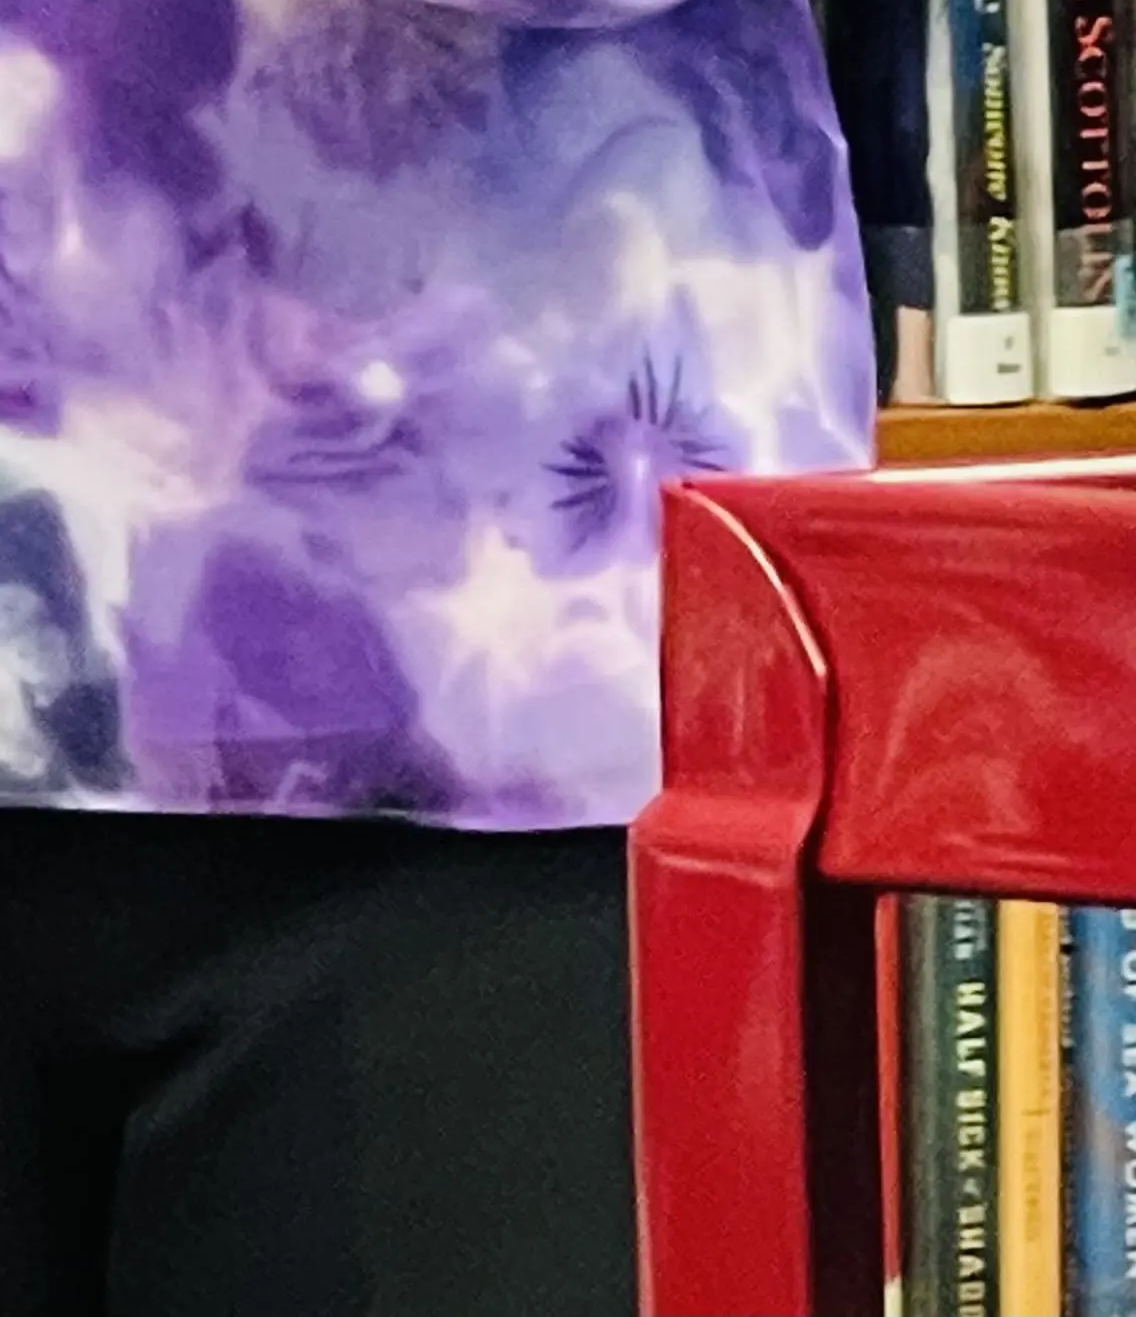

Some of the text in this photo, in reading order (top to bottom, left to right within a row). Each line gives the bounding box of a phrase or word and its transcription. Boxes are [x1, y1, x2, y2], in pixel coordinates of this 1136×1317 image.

[1071, 17, 1114, 304] SCOTTOLIN
[956, 982, 986, 1077] HALF
[957, 1090, 987, 1171] SICK
